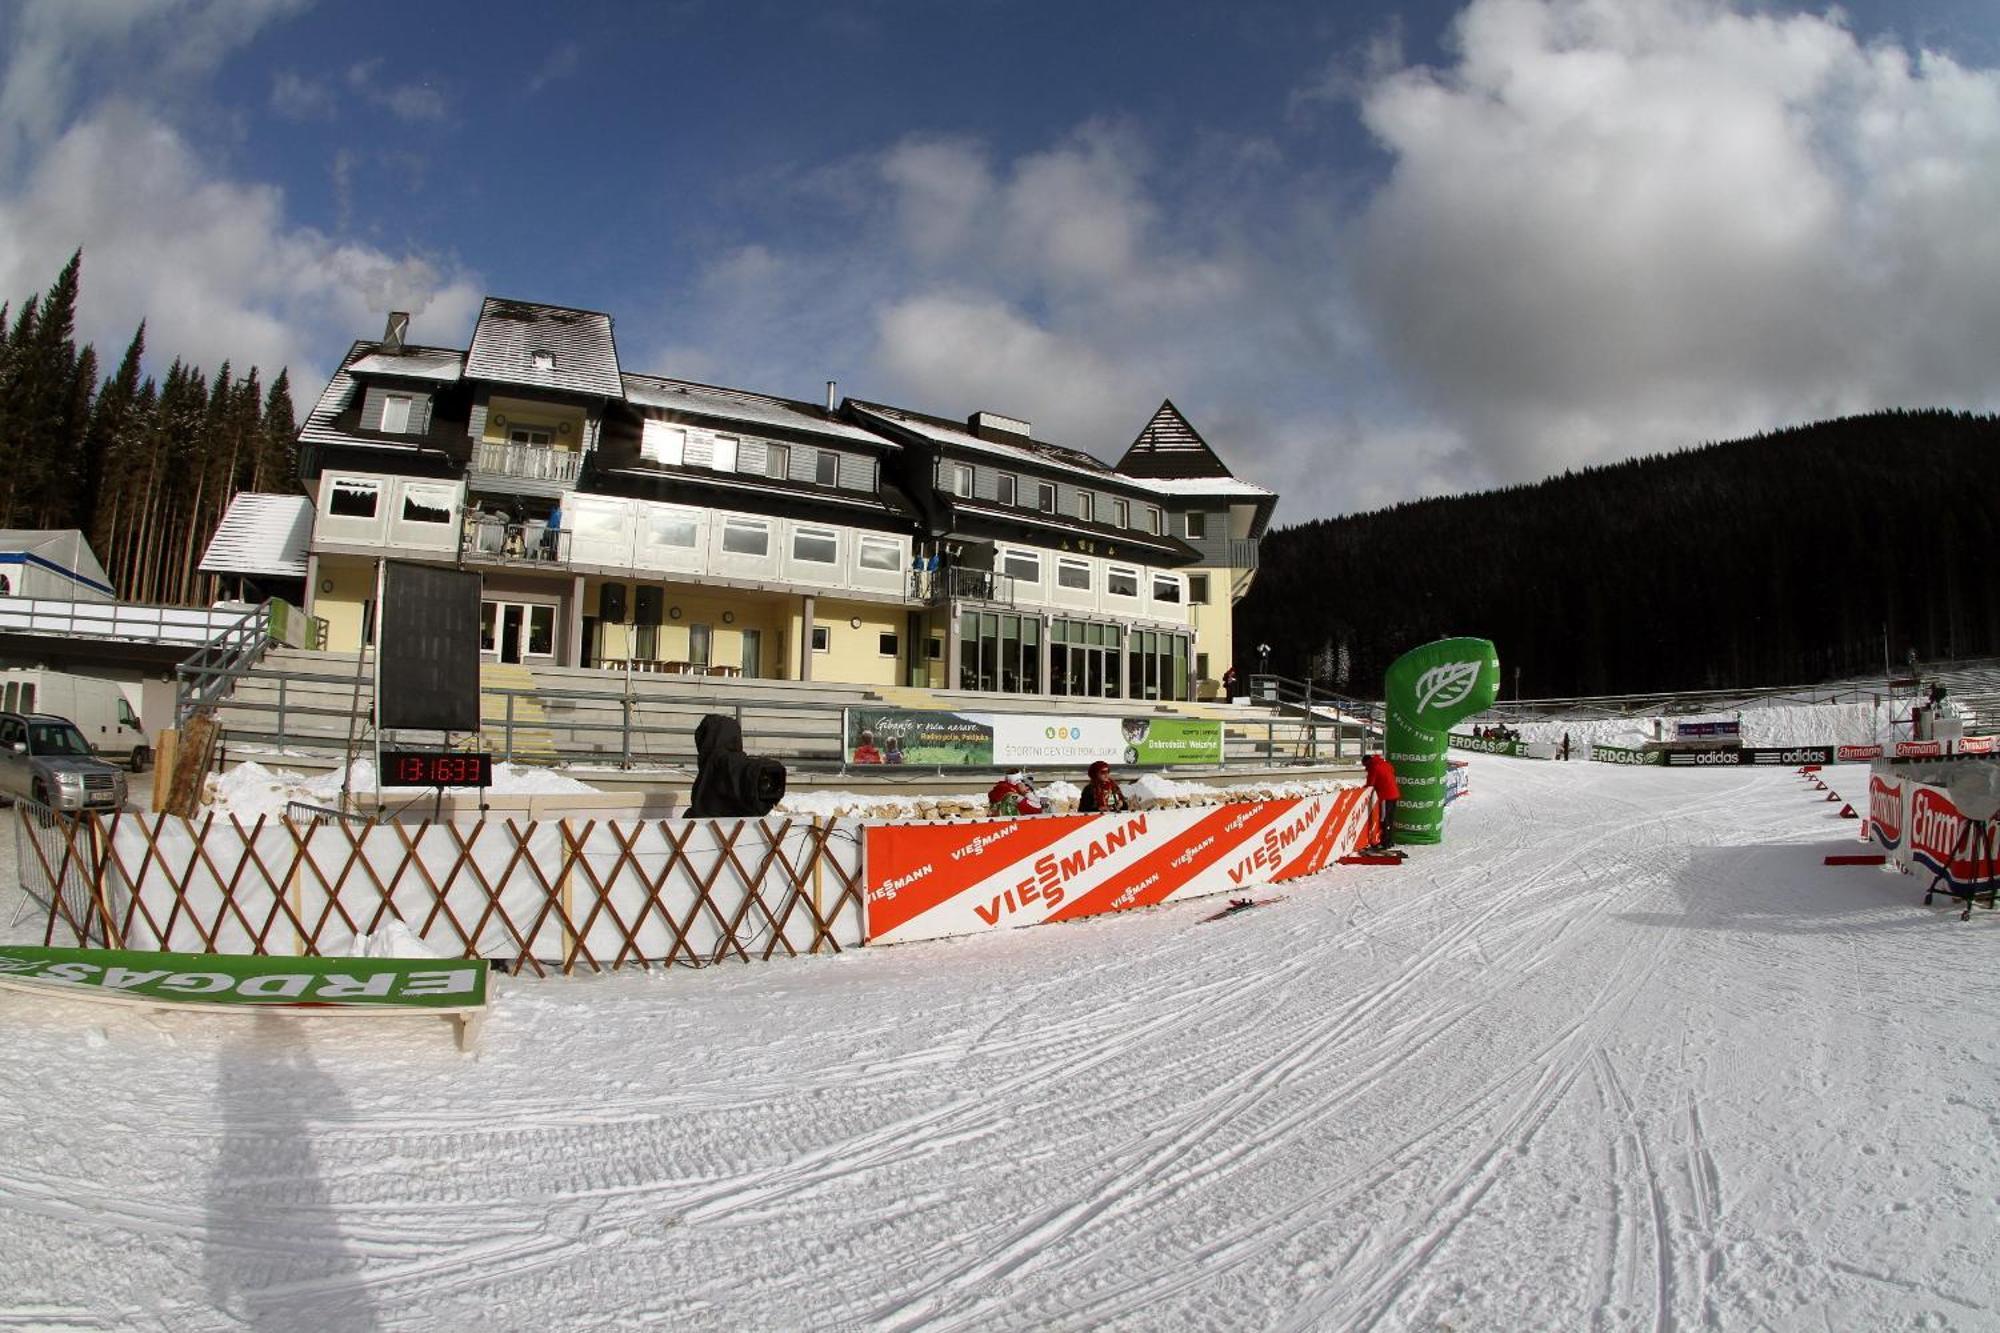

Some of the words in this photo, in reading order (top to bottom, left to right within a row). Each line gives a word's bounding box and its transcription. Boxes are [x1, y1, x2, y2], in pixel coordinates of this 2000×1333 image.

[876, 717, 913, 738] Gibanje
[1448, 735, 1496, 753] ERDGAS
[1838, 745, 1882, 759] Ehrmann
[1898, 742, 1938, 755] Ehrmann
[1591, 750, 1645, 764] ERDGAS
[1696, 750, 1739, 764] adidas
[1782, 748, 1825, 763] adidas
[400, 758, 480, 781] 13:16:33
[1396, 776, 1426, 786] RDGAS
[1397, 801, 1425, 809] DGAS
[1224, 803, 1264, 834] VIESSMANN
[951, 823, 1019, 861] VIESSMANN
[1170, 835, 1215, 869] VIESSMANN
[1227, 799, 1321, 885] VIESSMANN
[973, 813, 1148, 926] VIESSMANN
[1110, 871, 1160, 909] VIESSMANN
[37, 962, 478, 998] ERDGAS
